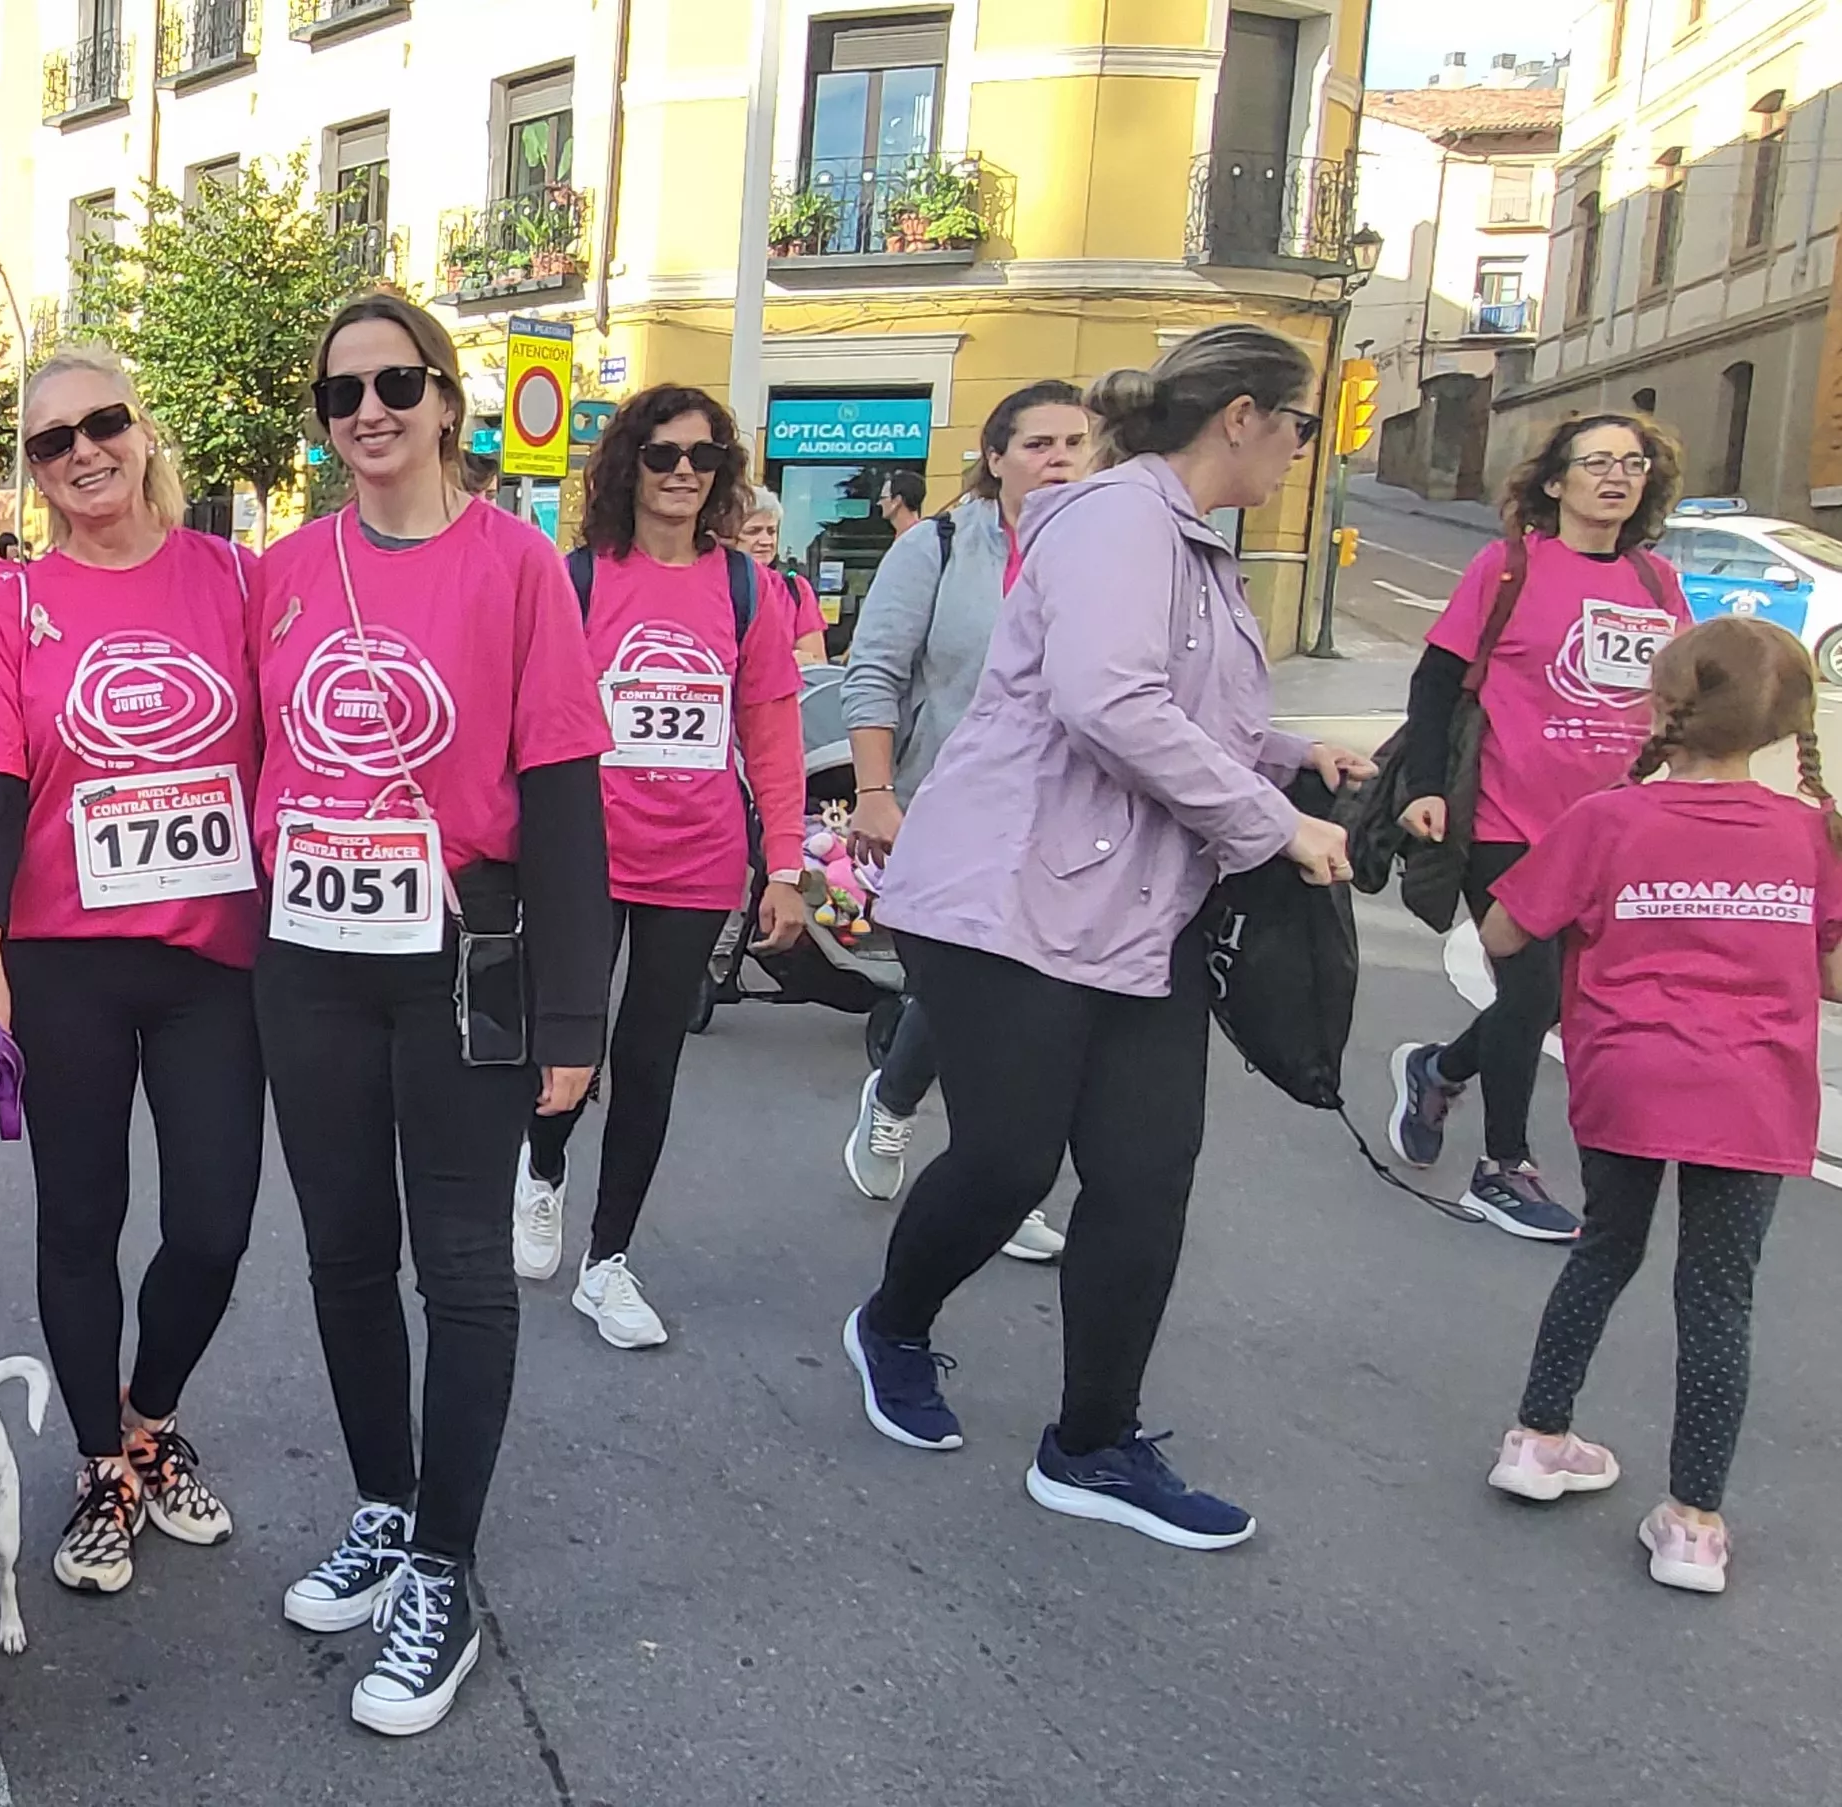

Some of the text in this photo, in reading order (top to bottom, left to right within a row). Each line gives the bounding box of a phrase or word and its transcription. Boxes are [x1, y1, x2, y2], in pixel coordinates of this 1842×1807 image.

[512, 341, 569, 362] ATENCIÓN
[774, 420, 921, 439] ÓPTICA GUARA
[797, 438, 895, 453] AUDIOLOGÍA
[629, 705, 705, 741] 332
[91, 790, 226, 818] CONTRA EL CÁNCER
[94, 811, 232, 869] 1760
[340, 847, 359, 860] EL
[361, 844, 420, 859] CÁNCER
[287, 858, 419, 915] 2051
[1617, 878, 1815, 905] ALTOARAGÓN
[1636, 904, 1799, 919] SUPERMERCADOS
